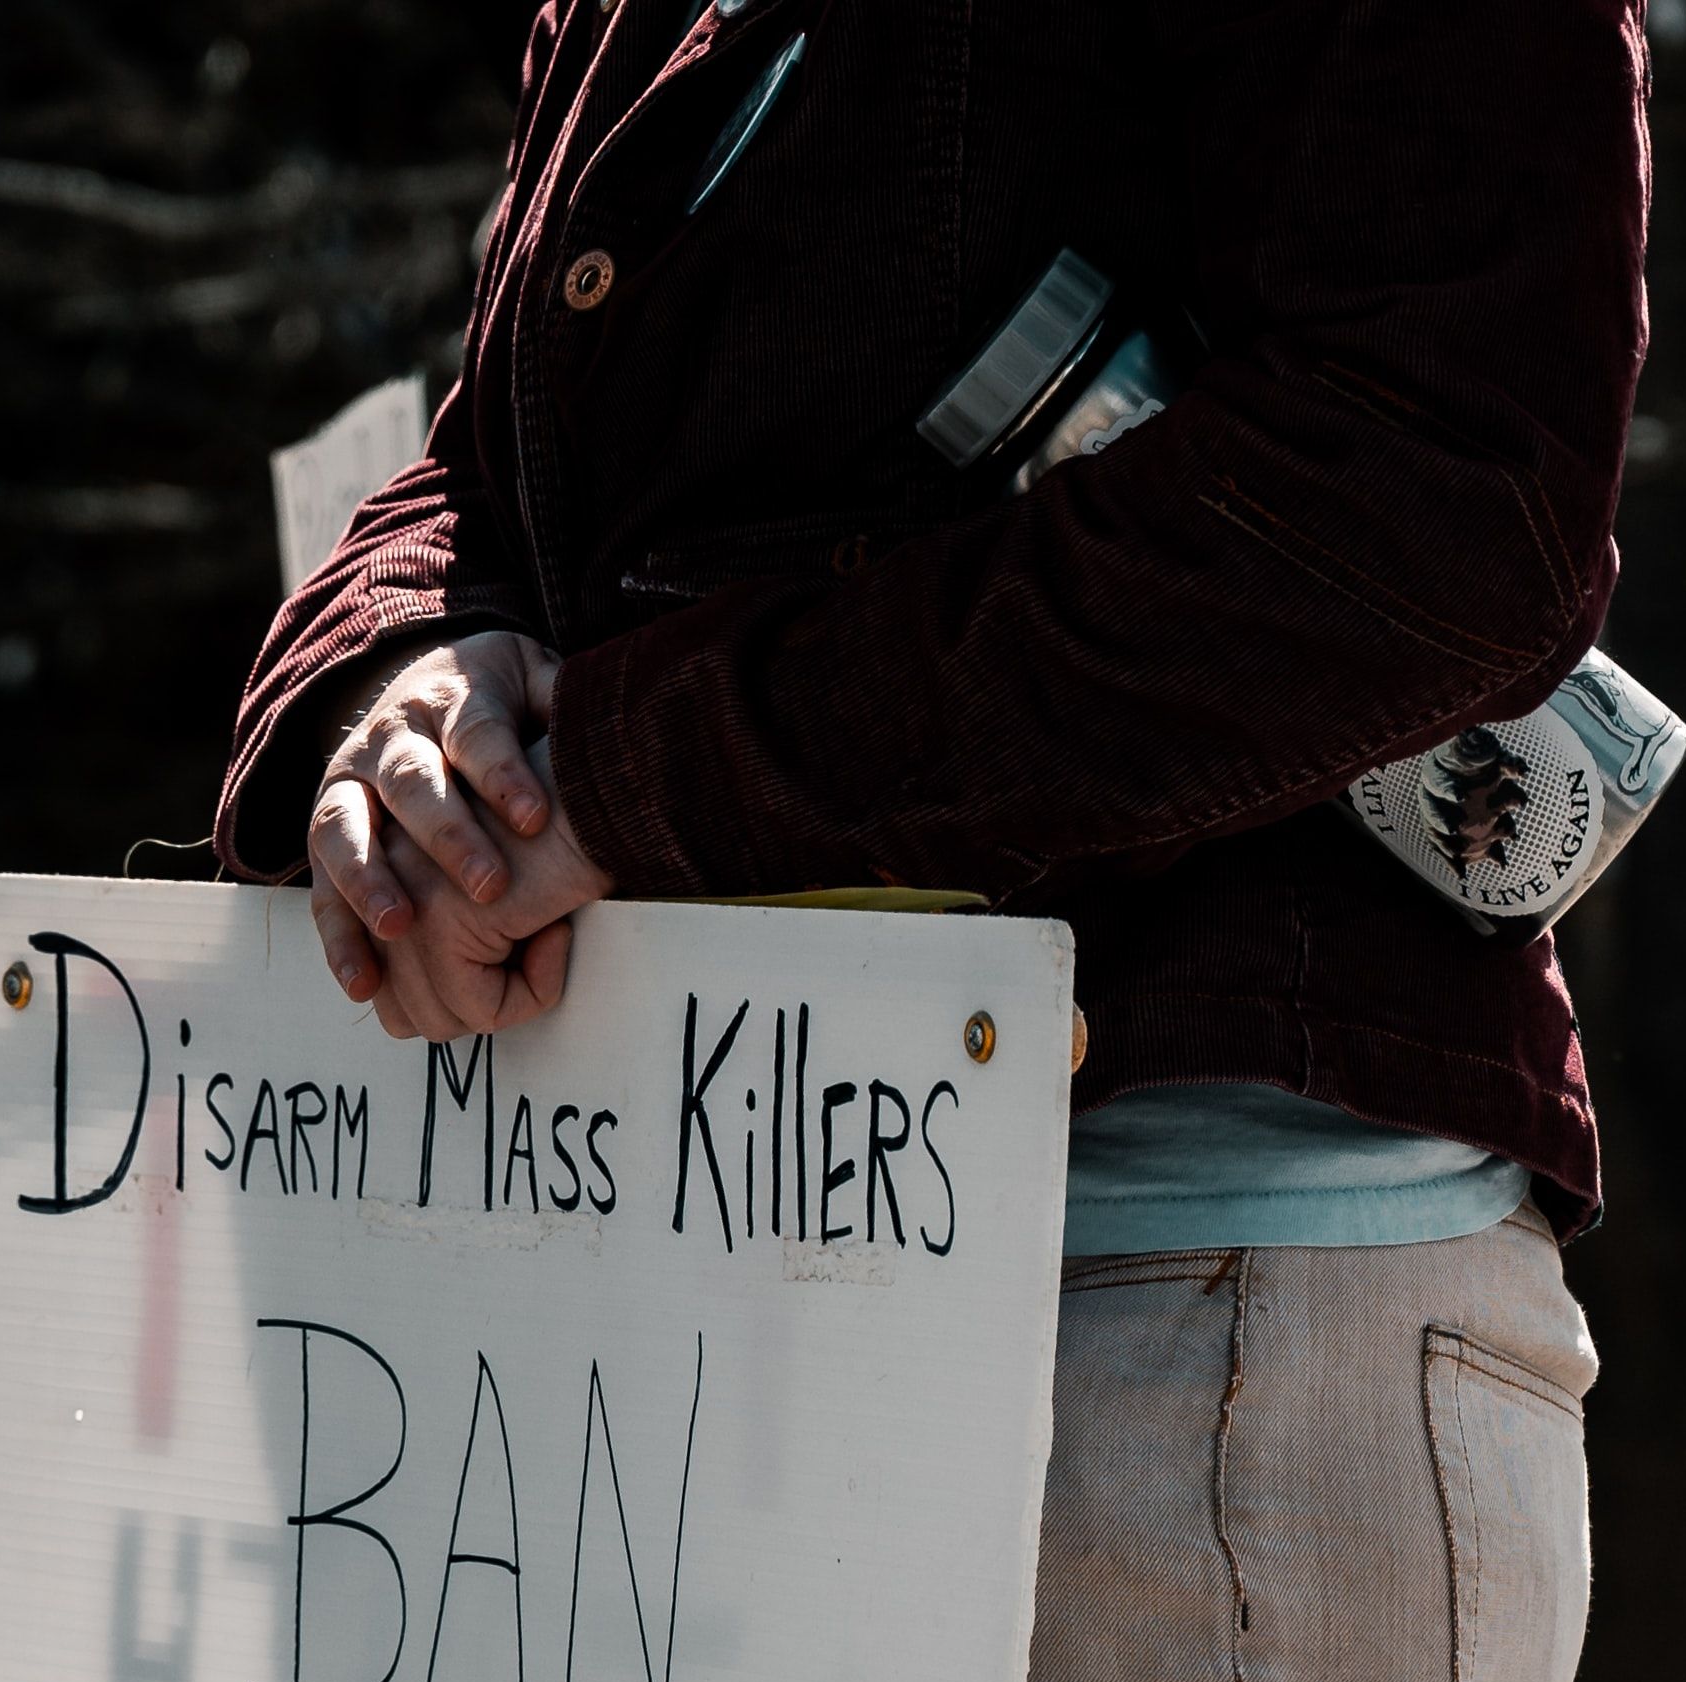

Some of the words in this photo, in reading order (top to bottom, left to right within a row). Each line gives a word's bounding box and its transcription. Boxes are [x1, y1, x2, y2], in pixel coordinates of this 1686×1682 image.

[1481, 874, 1551, 906] LIVE
[1551, 769, 1590, 880] AGAIN
[418, 1033, 618, 1214] MASS
